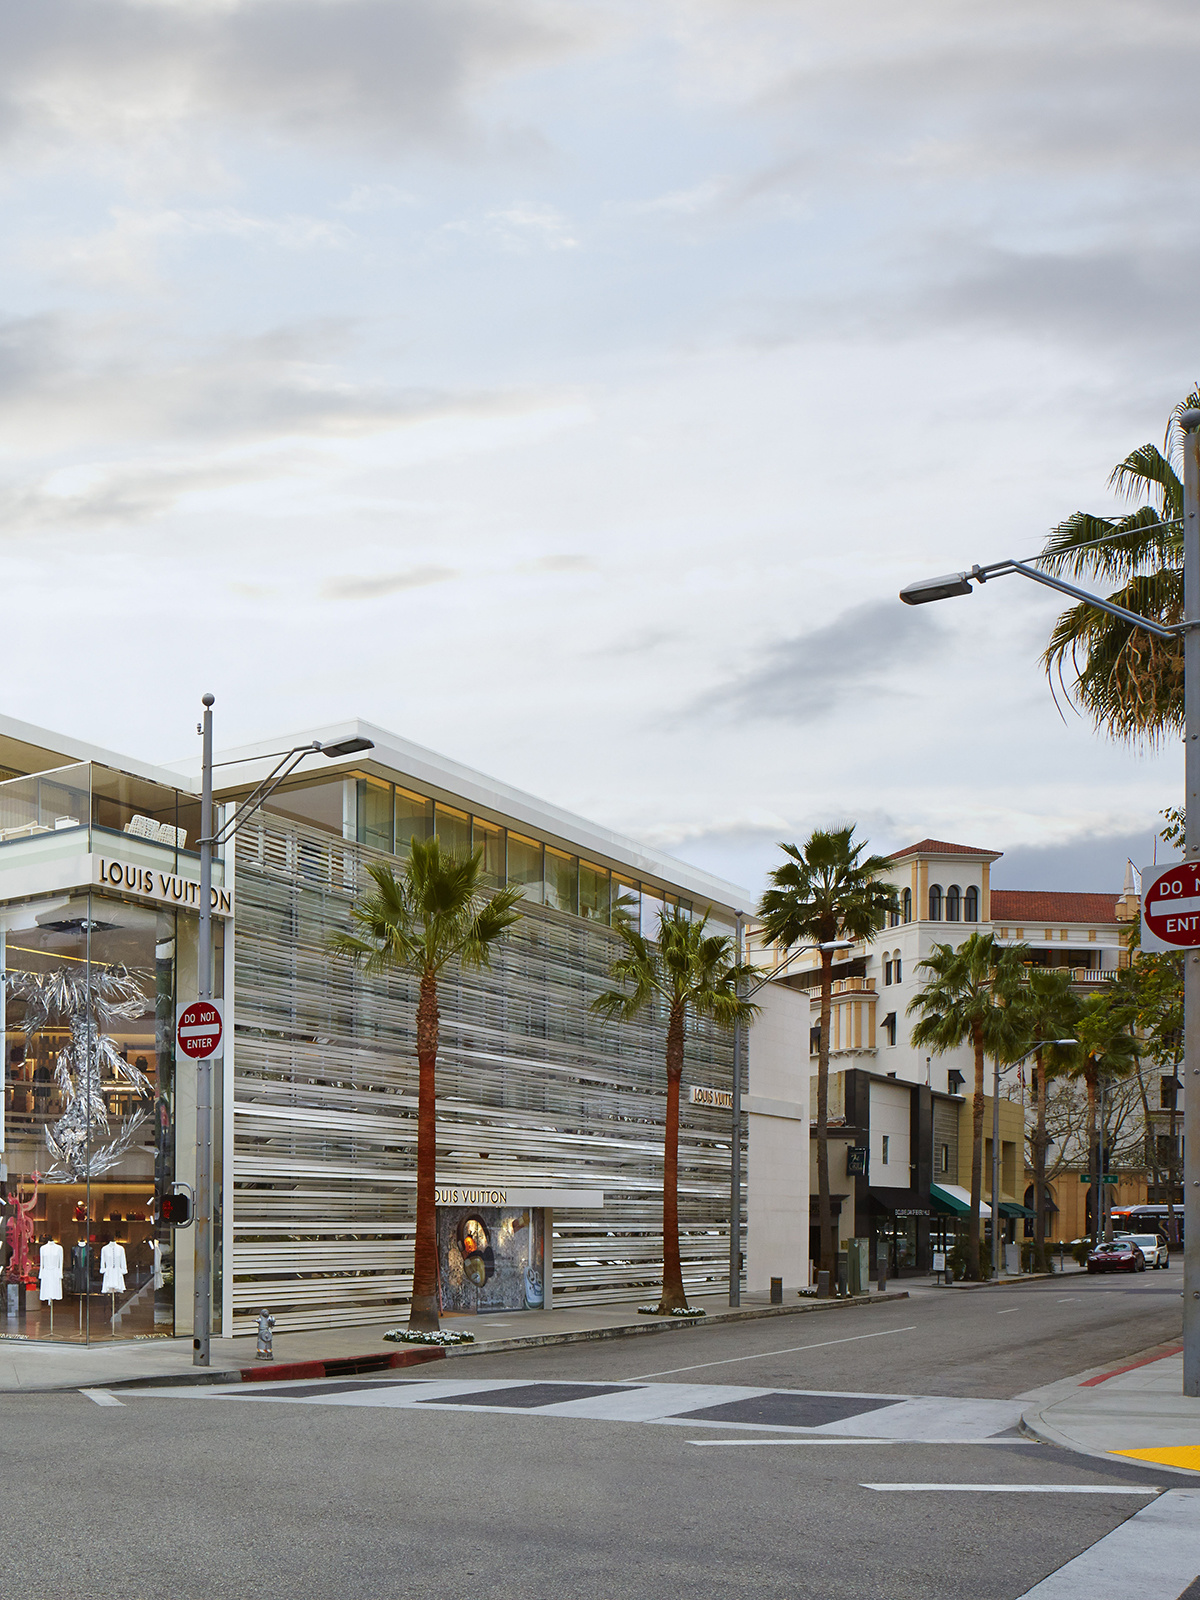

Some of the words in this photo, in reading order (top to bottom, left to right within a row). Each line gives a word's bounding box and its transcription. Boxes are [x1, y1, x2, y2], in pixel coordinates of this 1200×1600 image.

[99, 859, 153, 893] LOUIS
[158, 874, 231, 913] VUITON
[1160, 880, 1183, 896] DO
[1166, 916, 1200, 933] ENT
[184, 1013, 196, 1024] DO
[200, 1011, 216, 1022] NOT
[187, 1037, 212, 1049] ENTER
[435, 1189, 459, 1204] OUIS
[461, 1190, 507, 1204] VUITTON
